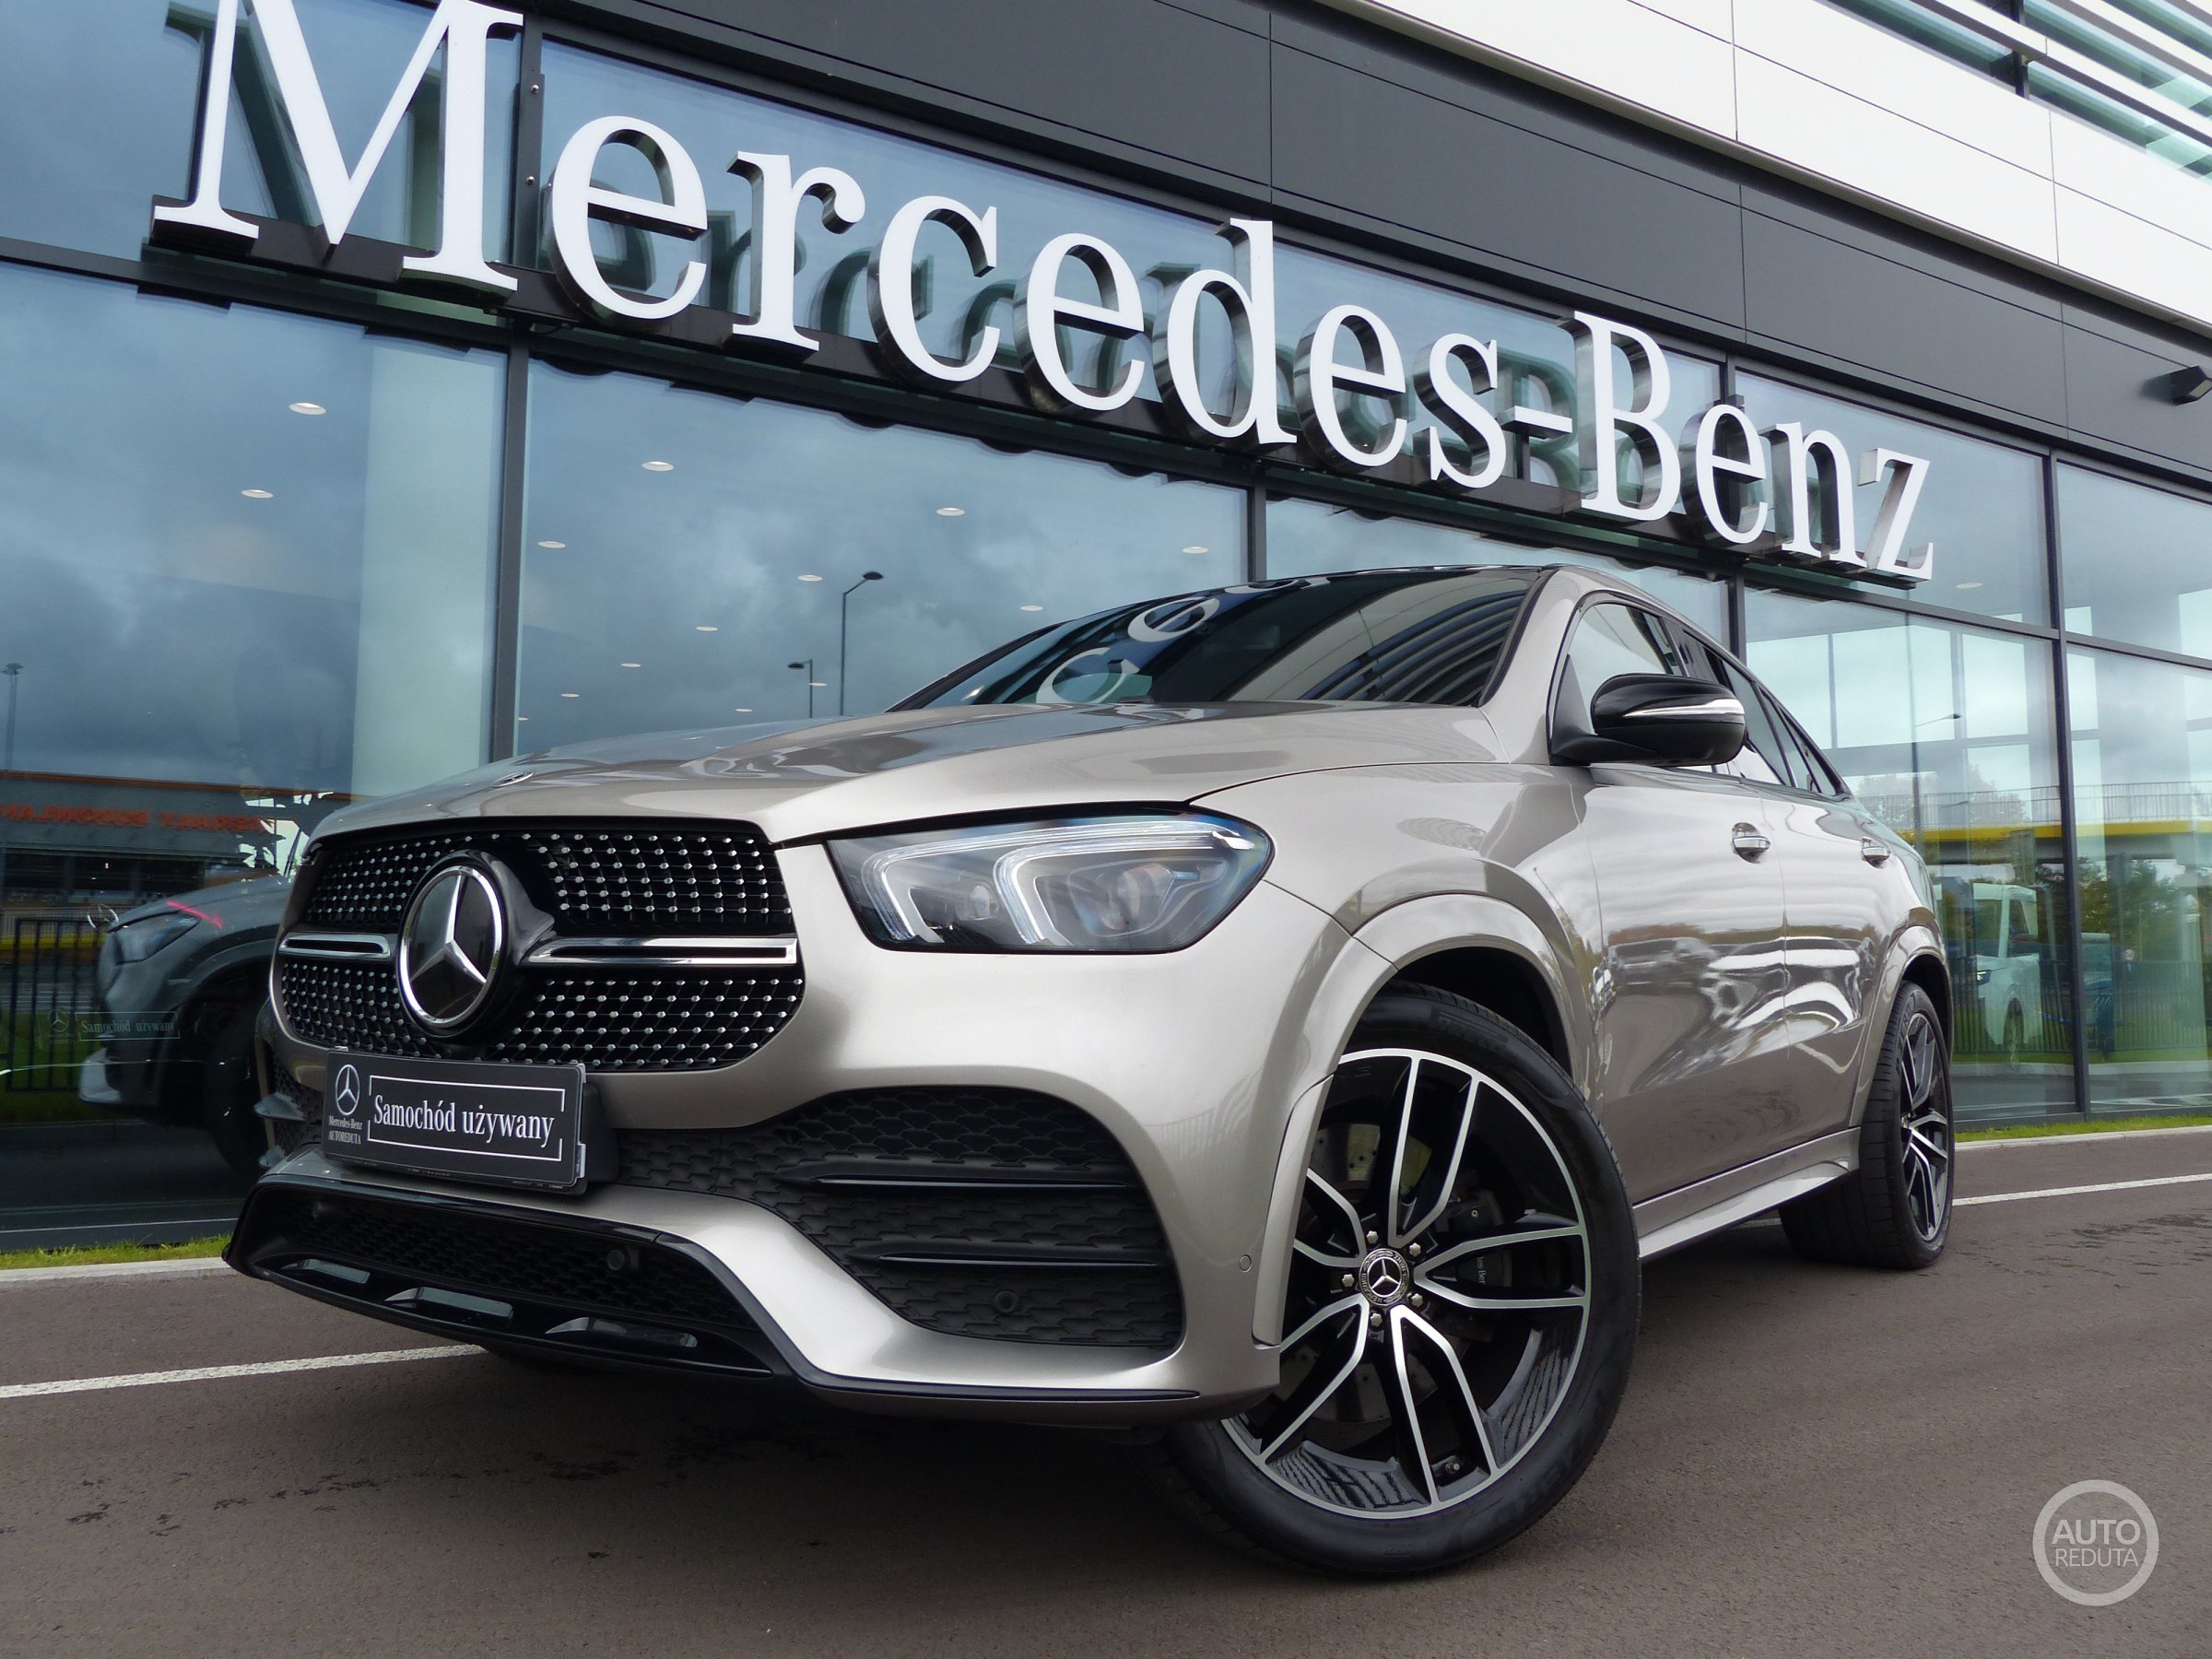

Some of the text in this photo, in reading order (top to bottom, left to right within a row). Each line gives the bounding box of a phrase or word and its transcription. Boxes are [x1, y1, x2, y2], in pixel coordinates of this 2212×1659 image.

[152, 0, 1933, 580] Mercedes-Benz
[373, 1093, 555, 1148] Samochód używany
